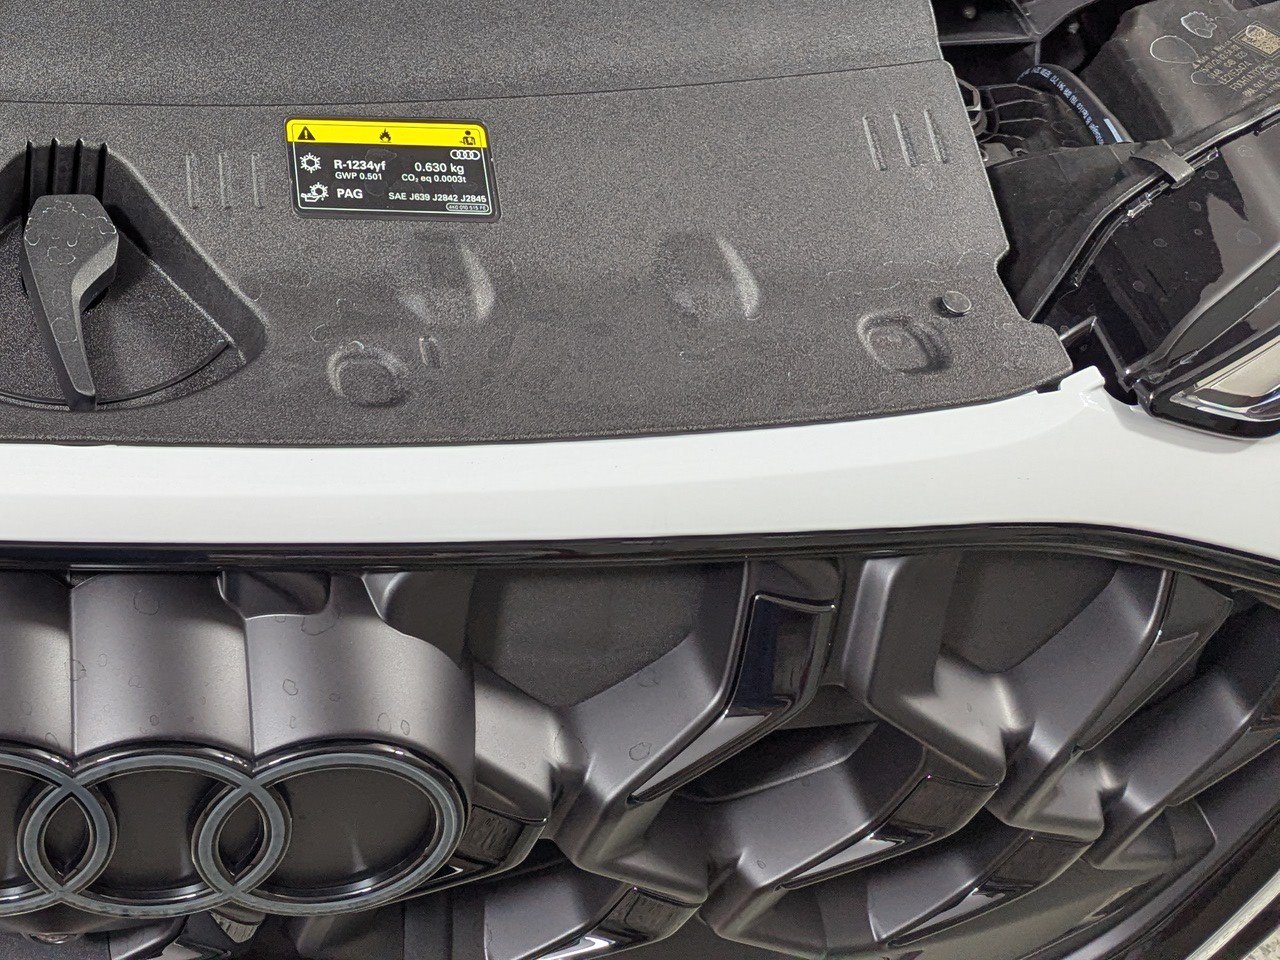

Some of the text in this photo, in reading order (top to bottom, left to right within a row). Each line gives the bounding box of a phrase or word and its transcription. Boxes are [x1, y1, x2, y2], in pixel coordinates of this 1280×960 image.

[333, 159, 385, 171] R-1234yf
[414, 161, 464, 174] 0.630 kg
[334, 171, 382, 180] GWP 0.501
[420, 175, 432, 183] eq
[433, 174, 466, 183] 0.0003t
[336, 188, 363, 198] PAG
[388, 191, 486, 202] SAE J639 J2842 J2845
